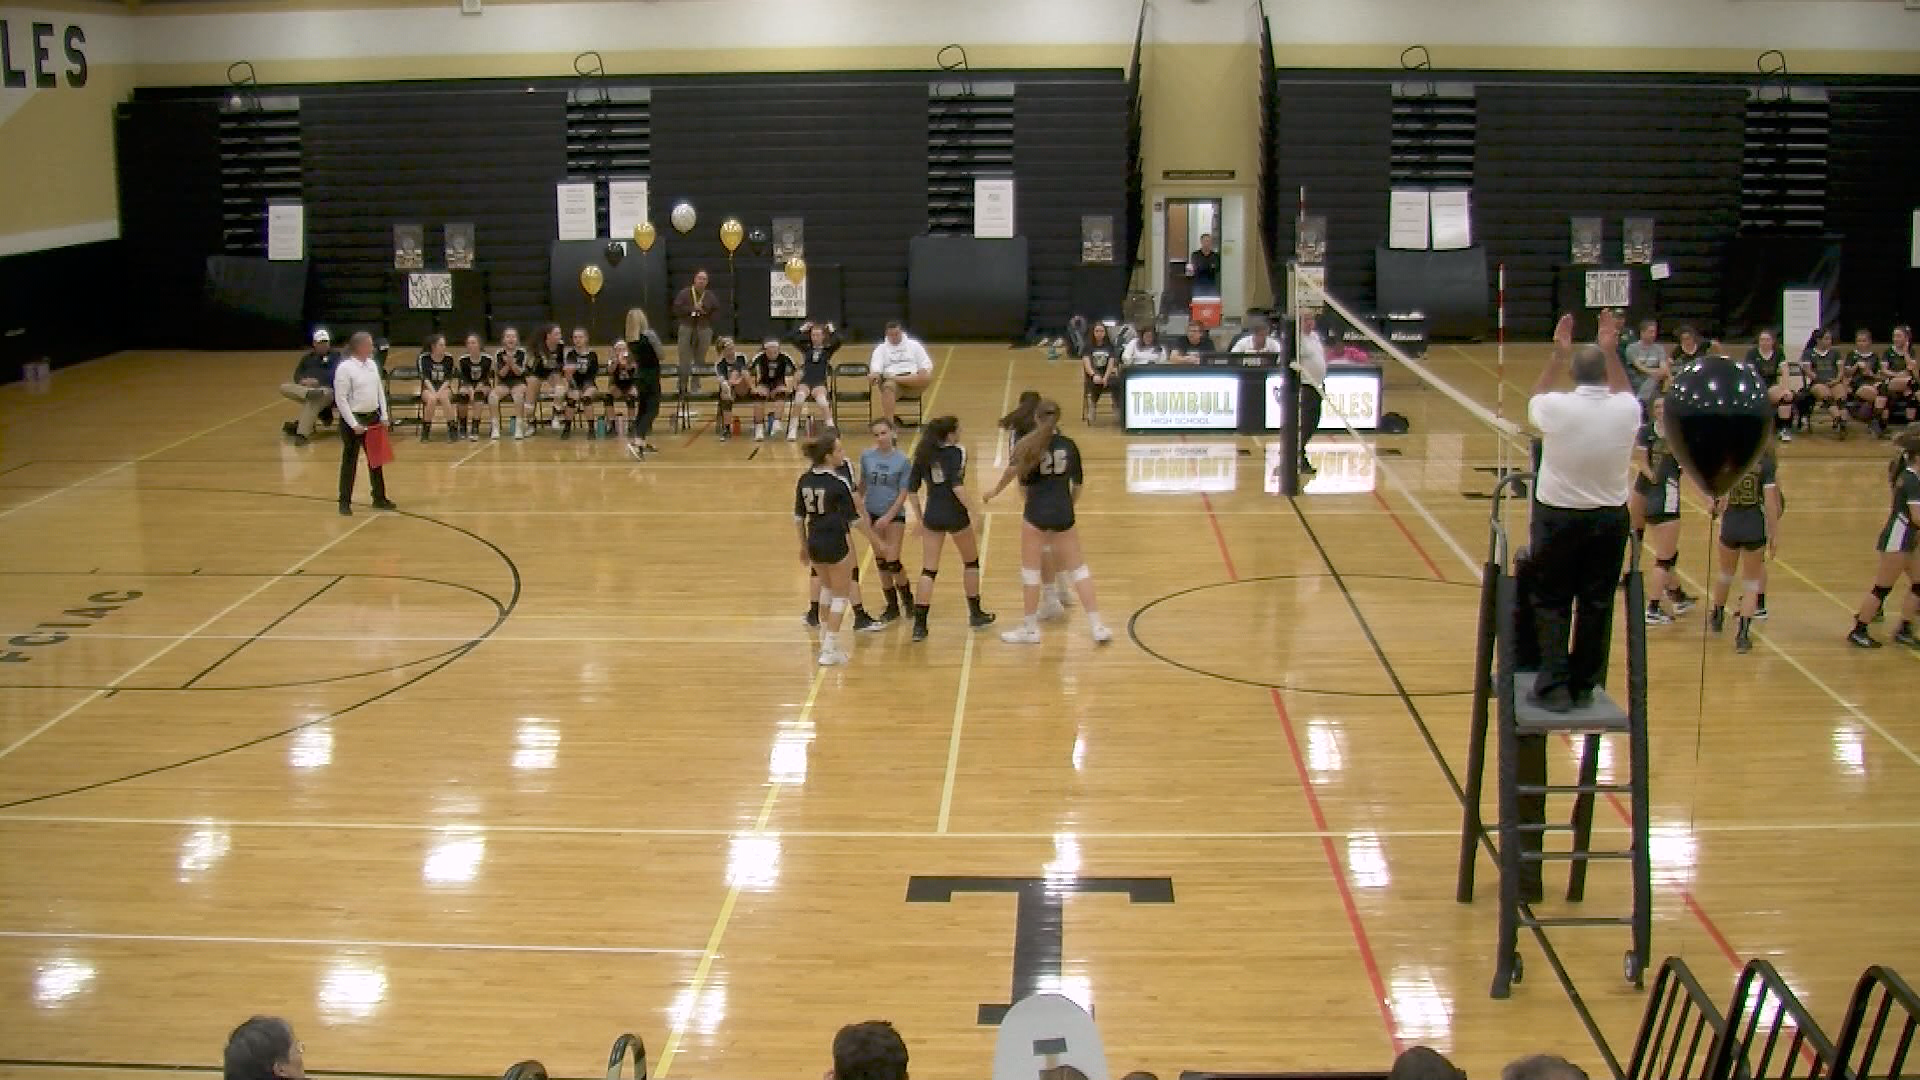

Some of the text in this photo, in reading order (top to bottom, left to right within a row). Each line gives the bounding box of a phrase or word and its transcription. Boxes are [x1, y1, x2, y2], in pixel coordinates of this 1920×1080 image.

[0, 20, 88, 88] LES
[1131, 391, 1234, 416] TRUMBULL
[801, 487, 825, 515] 27
